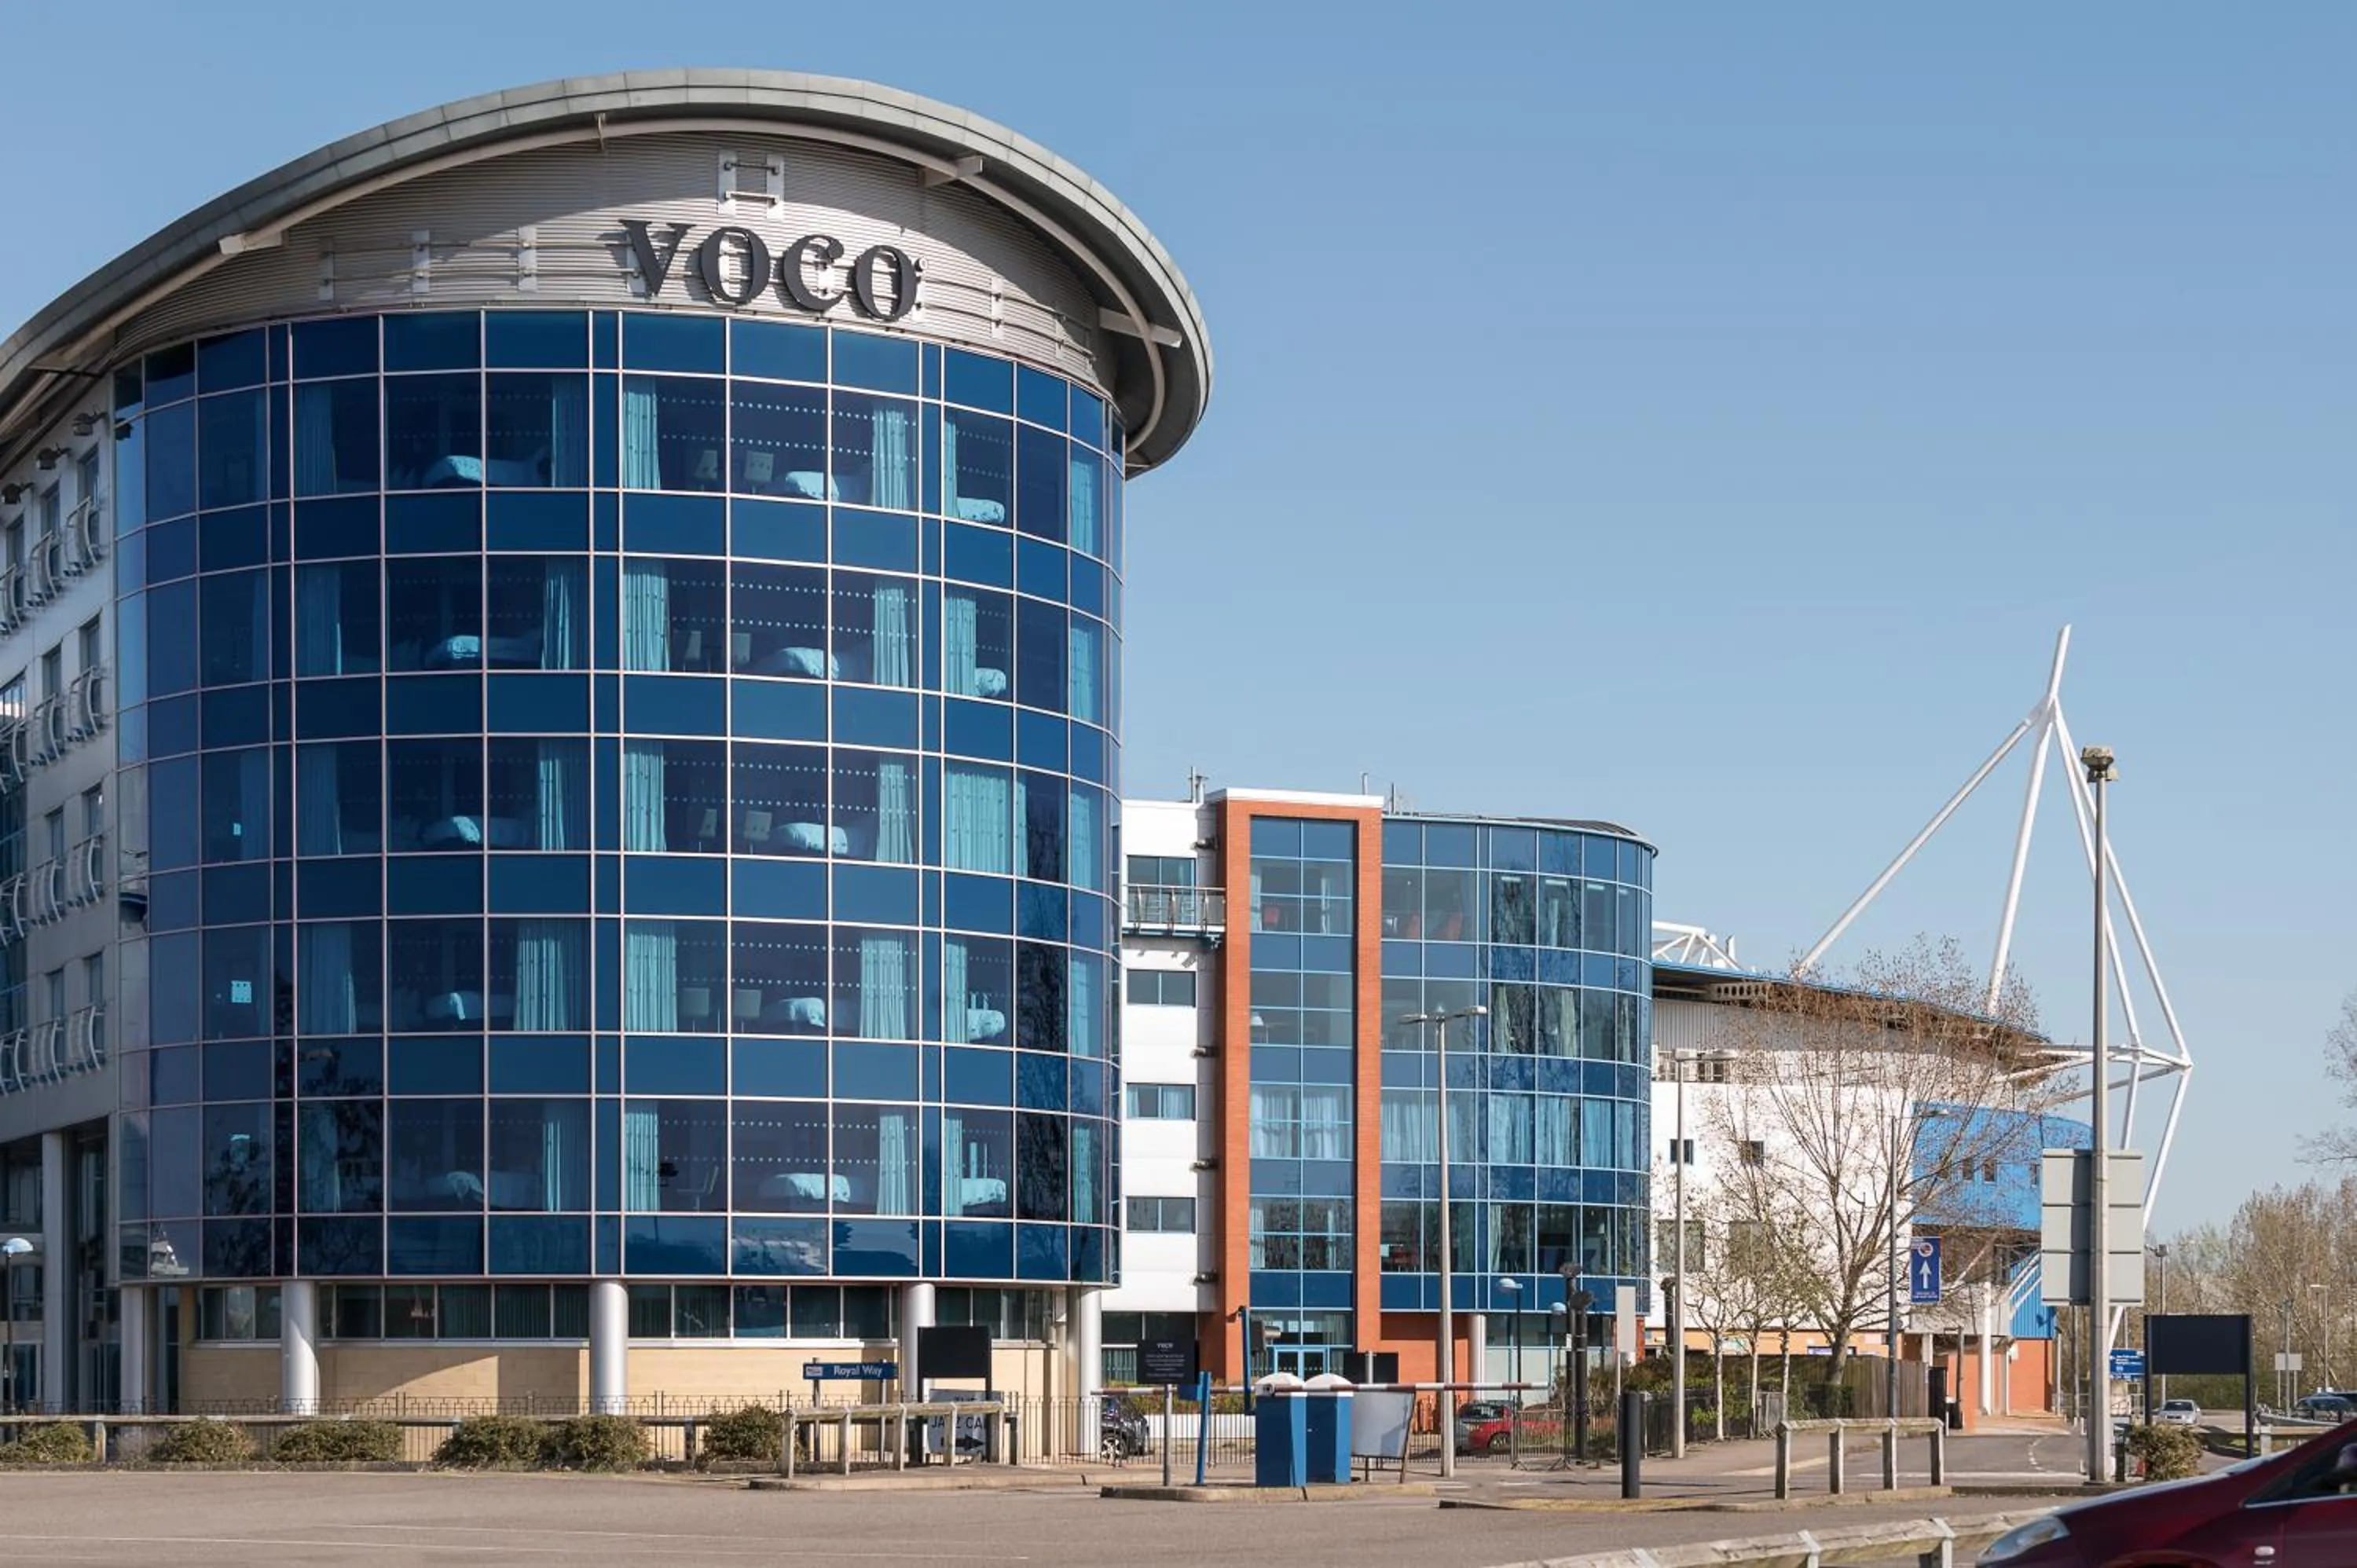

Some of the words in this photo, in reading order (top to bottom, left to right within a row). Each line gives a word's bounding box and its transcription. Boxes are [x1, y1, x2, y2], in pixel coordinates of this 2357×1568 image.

[833, 1365, 860, 1377] Royal
[862, 1365, 883, 1378] Way
[932, 1416, 961, 1429] JAZ
